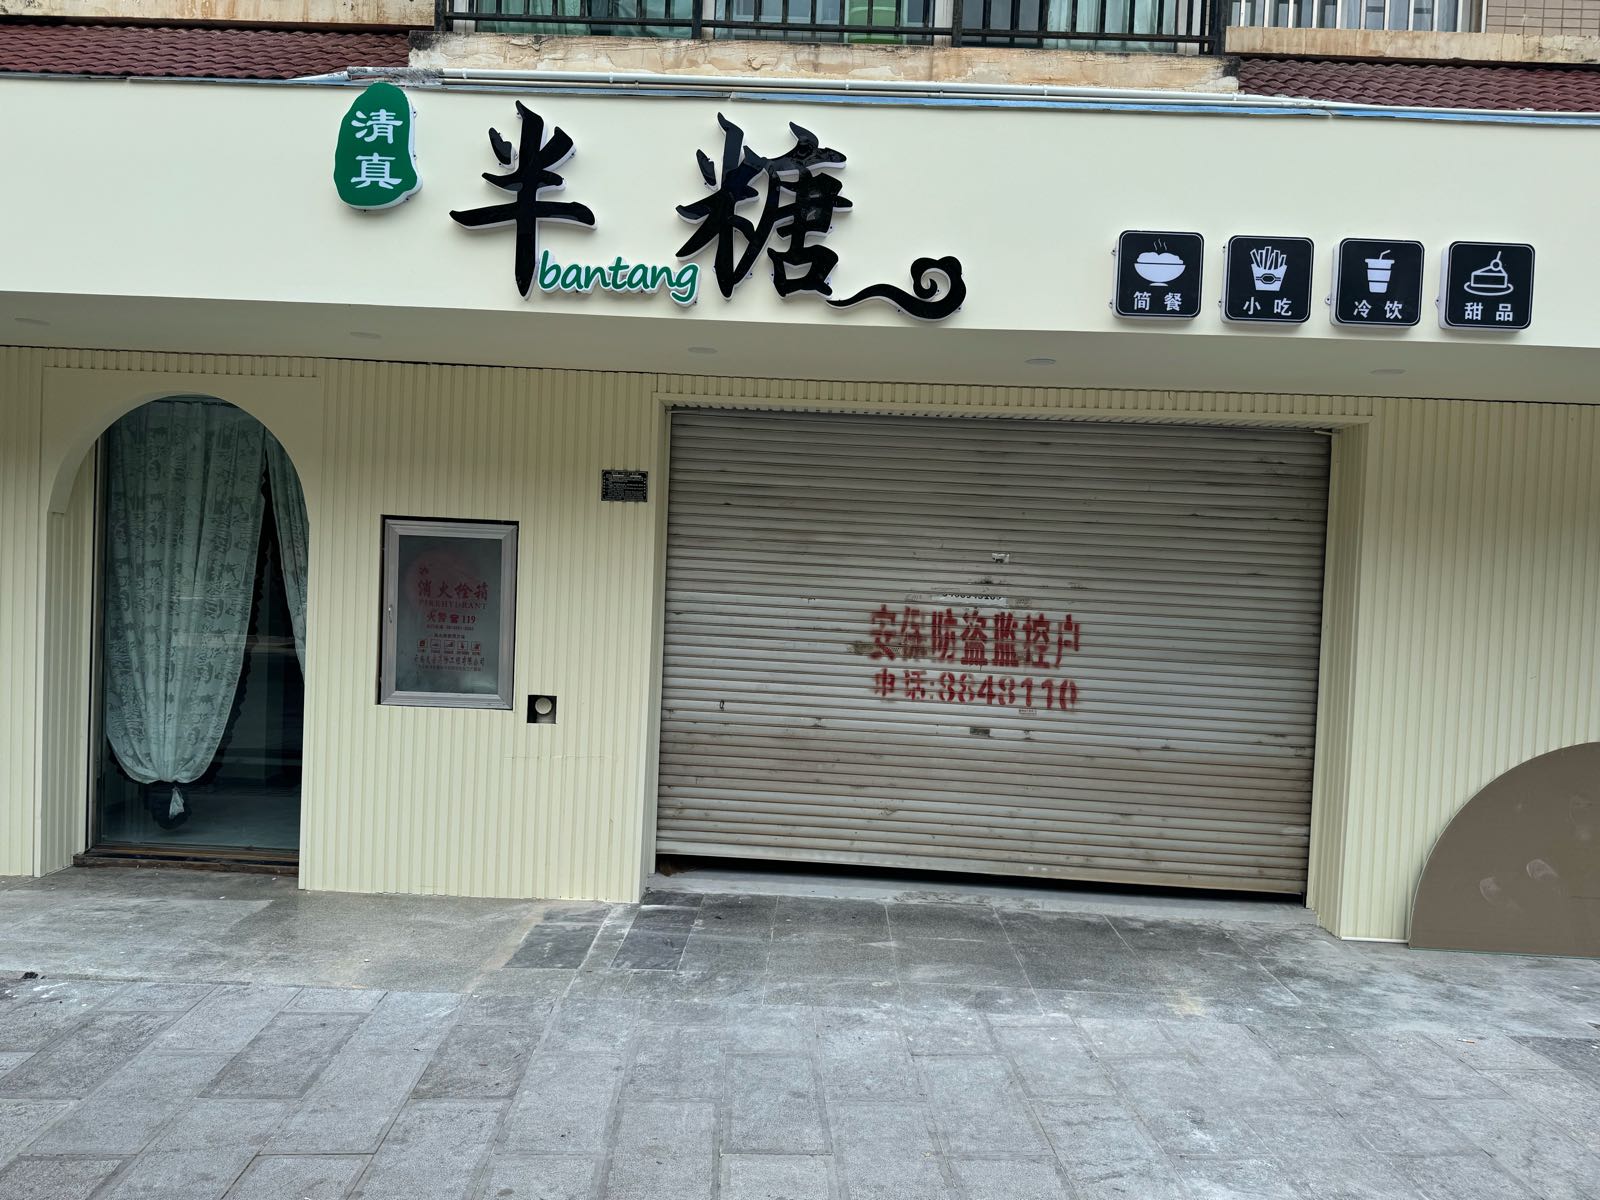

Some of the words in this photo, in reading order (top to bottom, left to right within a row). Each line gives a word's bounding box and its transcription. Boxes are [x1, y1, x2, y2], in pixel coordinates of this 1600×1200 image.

[350, 109, 404, 191] 清真
[450, 100, 854, 300] 半糖
[539, 250, 700, 303] bantang
[1133, 290, 1183, 312] 简餐
[1243, 296, 1293, 316] 小吃
[1353, 299, 1403, 320] 冷饮
[1463, 301, 1514, 322] 甜品
[417, 578, 489, 601] 消火栓箱
[462, 615, 476, 624] 119
